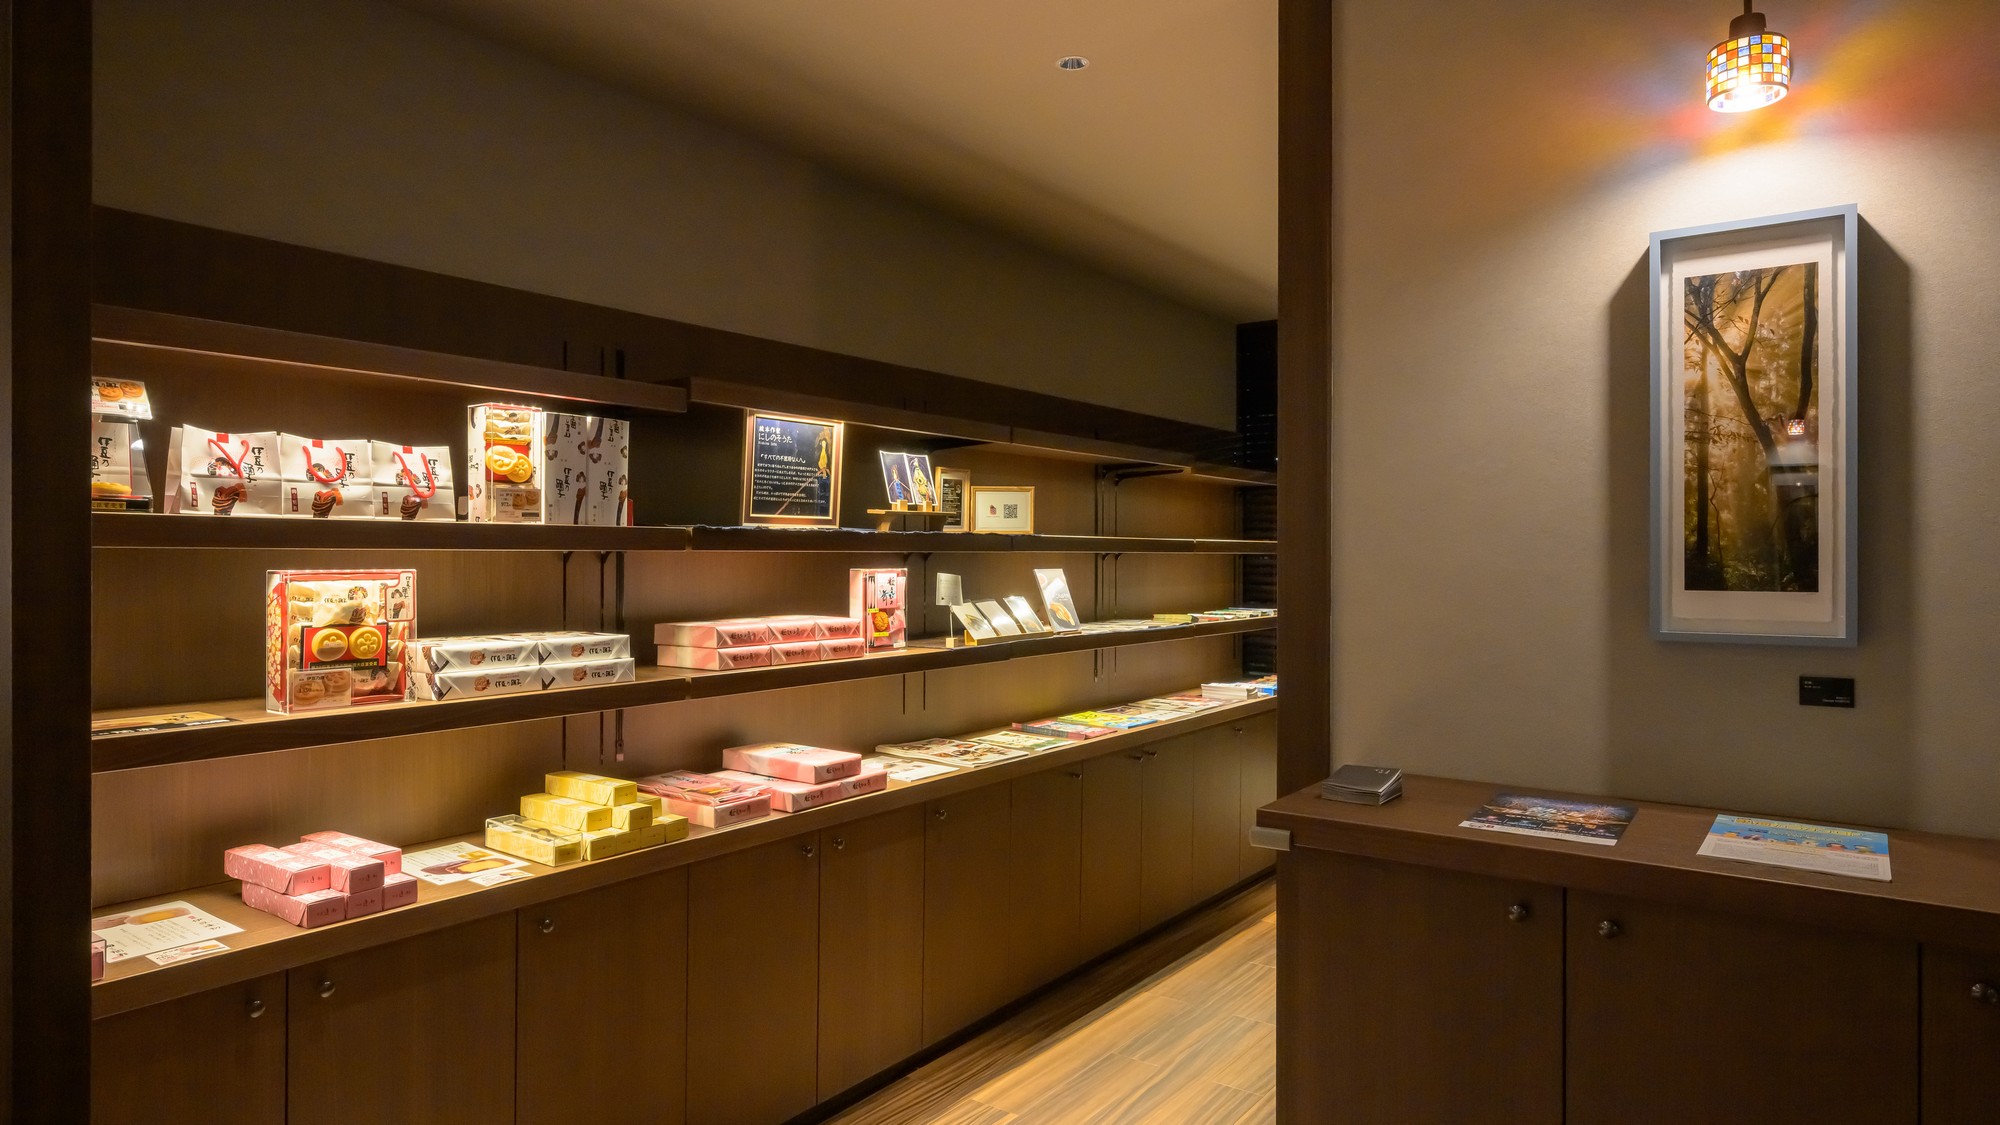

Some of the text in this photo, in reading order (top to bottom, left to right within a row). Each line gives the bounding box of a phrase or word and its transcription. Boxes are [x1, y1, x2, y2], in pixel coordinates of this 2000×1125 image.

[758, 432, 793, 444] にしのそうた
